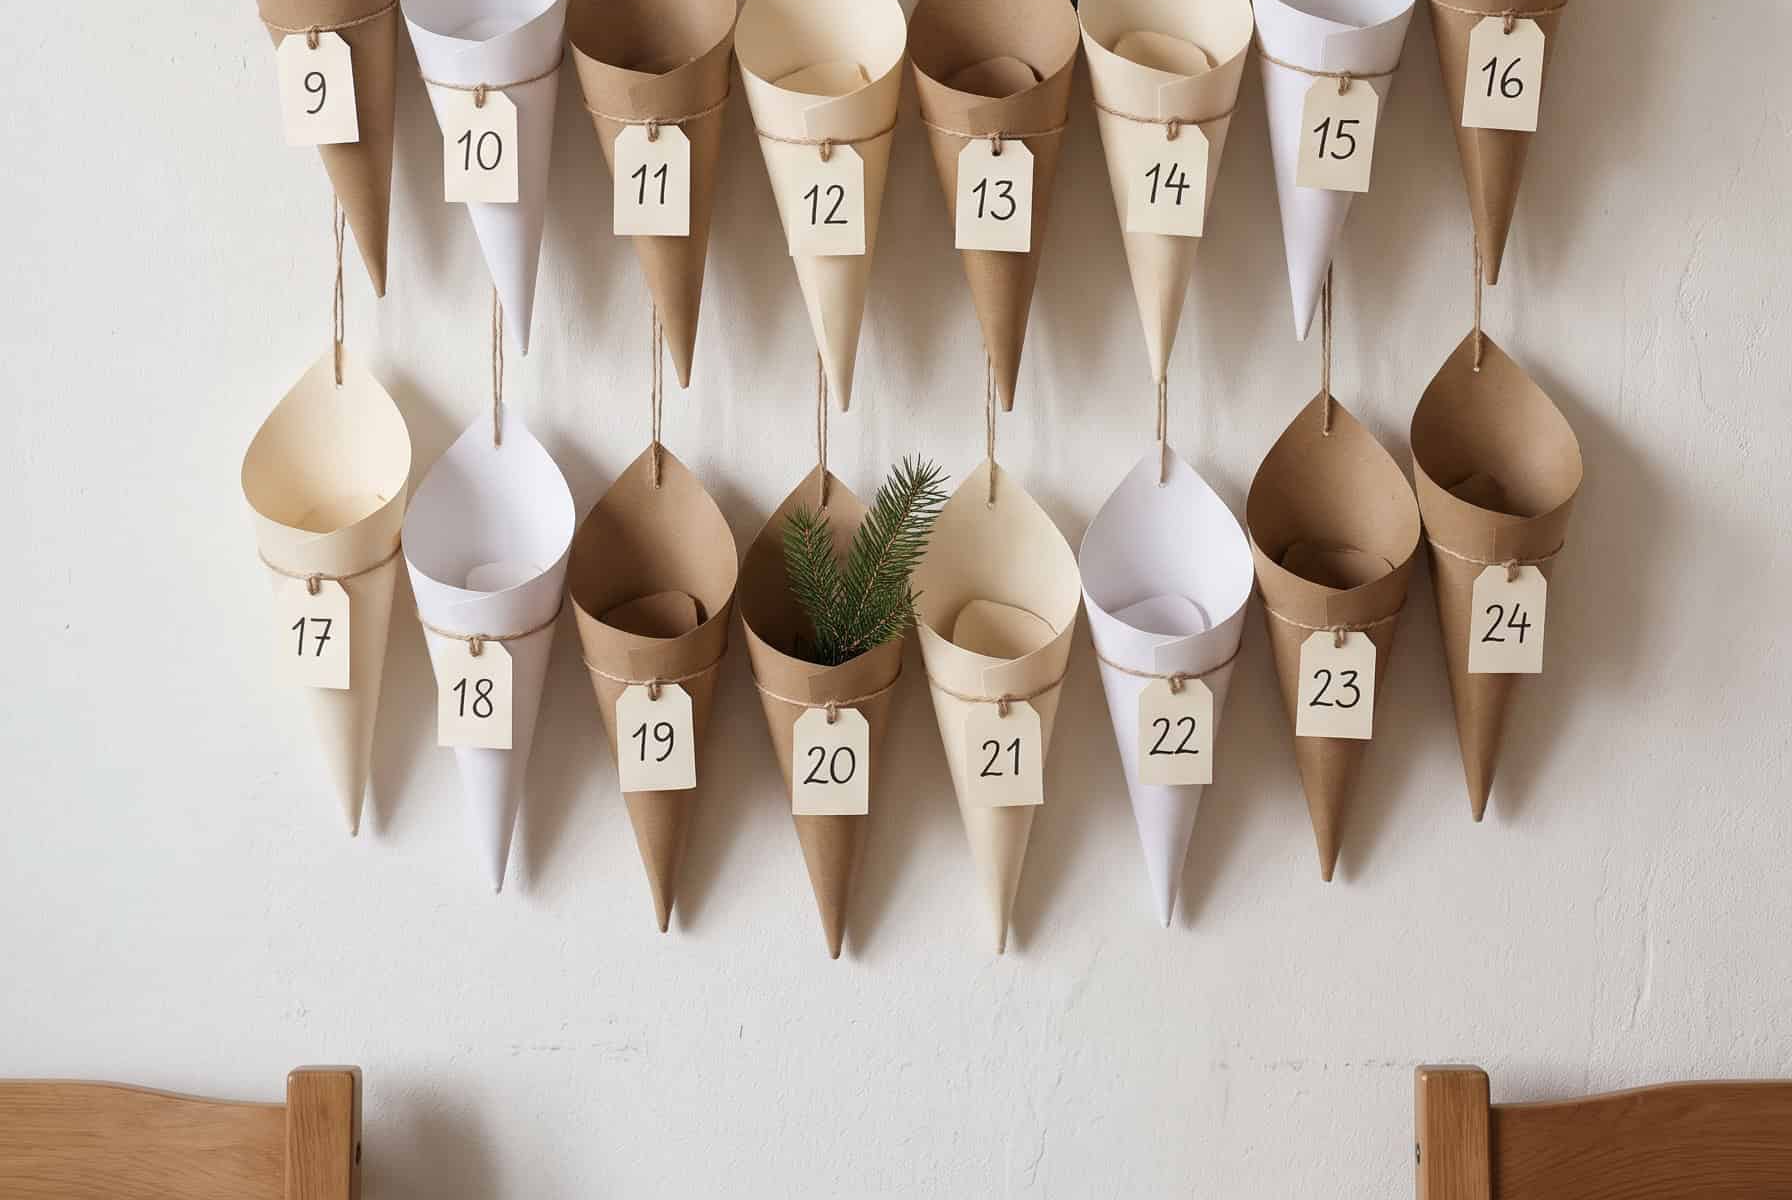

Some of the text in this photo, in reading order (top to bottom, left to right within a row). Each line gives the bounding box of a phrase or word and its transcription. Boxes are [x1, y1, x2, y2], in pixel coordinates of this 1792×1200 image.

[303, 71, 327, 115] 9
[1481, 56, 1524, 99] 16
[457, 129, 503, 171] 10
[1313, 116, 1361, 160] 15
[631, 163, 668, 206] 11
[803, 183, 849, 226] 12
[972, 177, 1017, 221] 13
[1144, 162, 1191, 206] 14
[291, 616, 333, 657] 17
[1481, 602, 1532, 644] 24
[452, 677, 494, 719] 18
[1308, 668, 1361, 709] 23
[631, 721, 675, 763] 19
[1148, 716, 1200, 756] 22
[803, 746, 856, 785] 20
[979, 737, 1021, 778] 21
